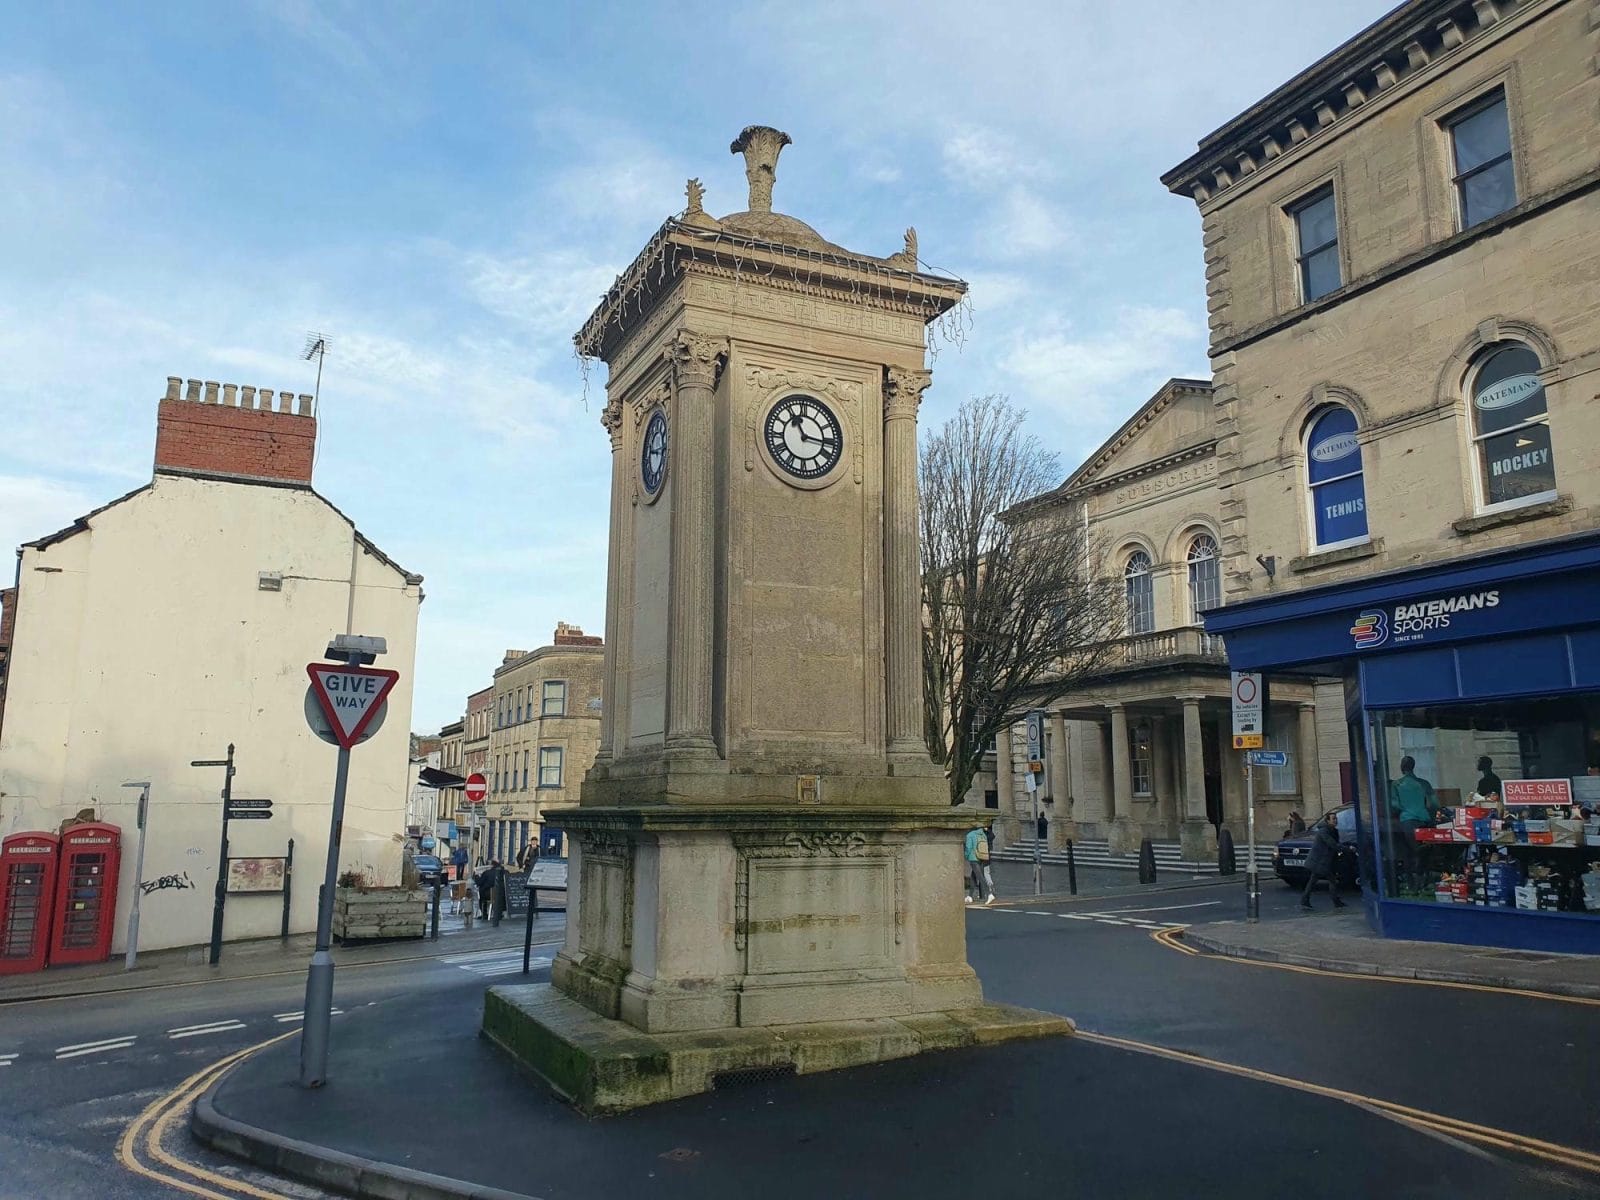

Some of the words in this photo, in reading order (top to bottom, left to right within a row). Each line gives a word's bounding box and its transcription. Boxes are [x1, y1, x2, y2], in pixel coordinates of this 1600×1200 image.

[1481, 380, 1537, 404] BATEMANS
[1316, 440, 1358, 456] BATEMANS
[1492, 448, 1548, 476] HOCKEY
[1325, 498, 1364, 519] TENNIS
[1394, 590, 1500, 621] BATEMAN'S
[1393, 614, 1450, 635] SPORTS
[325, 674, 376, 694] GIVE
[335, 696, 367, 708] WAY
[1506, 784, 1534, 794] SALE
[1537, 783, 1566, 794] SALE
